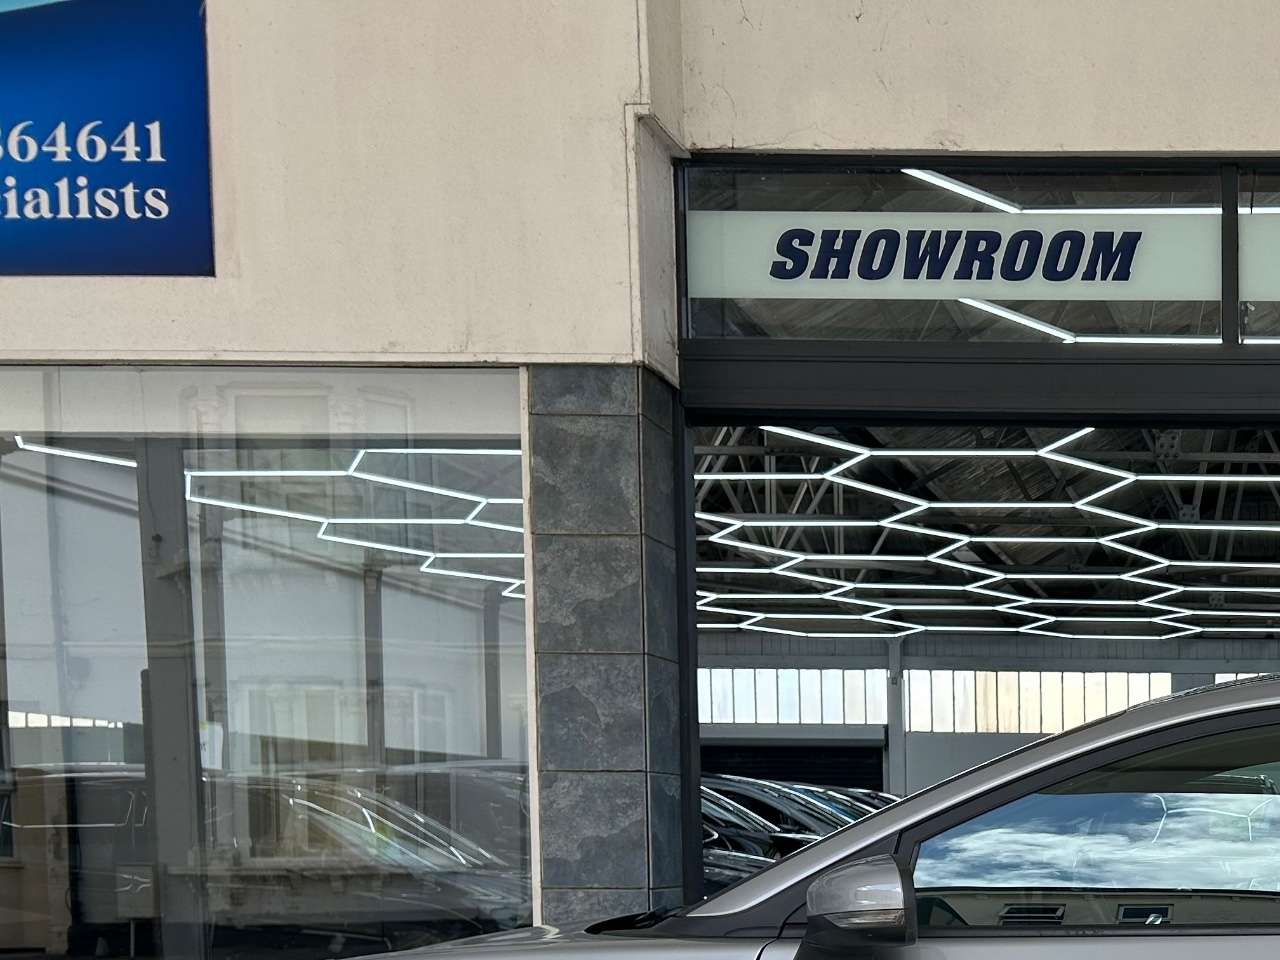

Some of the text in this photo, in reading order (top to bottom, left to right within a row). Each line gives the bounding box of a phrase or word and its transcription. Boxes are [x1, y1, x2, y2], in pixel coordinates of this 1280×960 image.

[0, 120, 167, 163] 64641
[0, 175, 170, 219] ialists
[769, 228, 1142, 282] SHOWROOM
